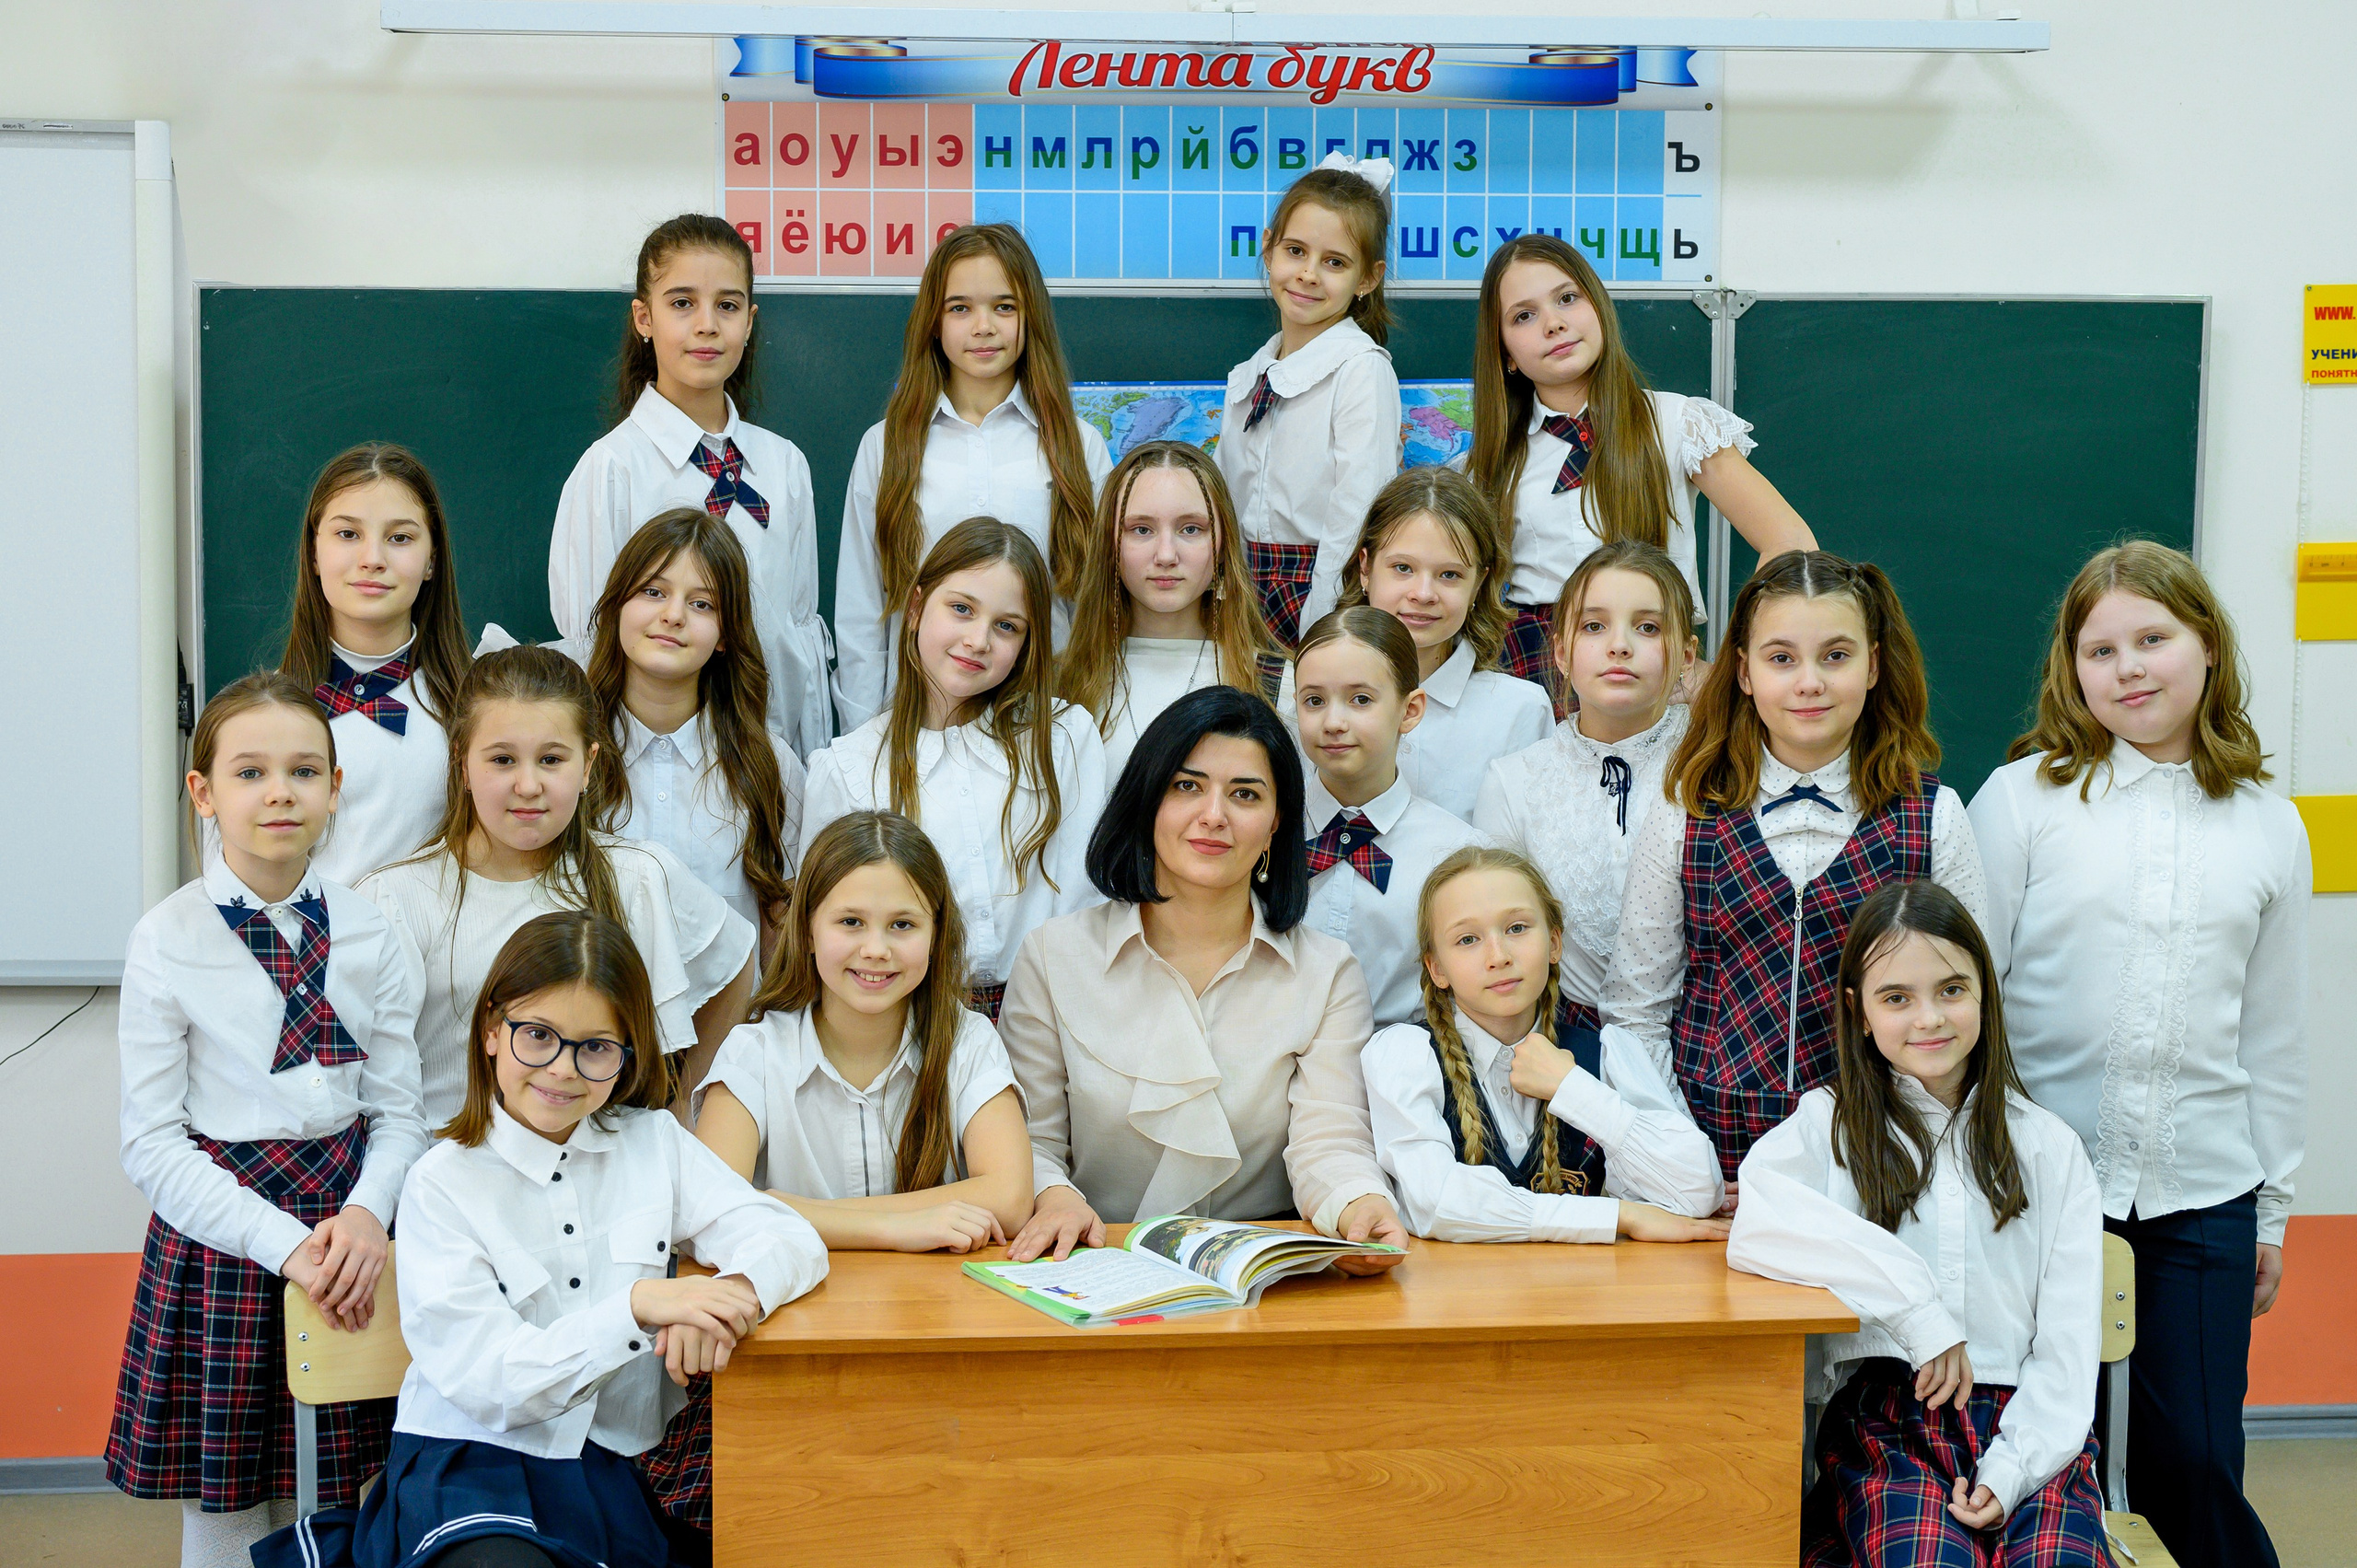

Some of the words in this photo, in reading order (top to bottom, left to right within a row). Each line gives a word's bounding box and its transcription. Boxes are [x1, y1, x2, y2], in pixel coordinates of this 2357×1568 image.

[1008, 40, 1253, 97] Лента
[1267, 45, 1435, 105] букв
[735, 133, 761, 167] а
[779, 133, 810, 167] о
[830, 134, 859, 179] у
[878, 135, 919, 167] ы
[935, 135, 963, 168] э
[984, 135, 1012, 168] н
[1032, 136, 1066, 168] м
[1081, 136, 1112, 169] л
[1132, 135, 1160, 180] р
[1182, 125, 1209, 169] й
[1229, 124, 1260, 169] б
[1278, 137, 1306, 169] в
[1402, 139, 1440, 171] ж
[1453, 138, 1478, 172] з
[782, 209, 809, 254] ё
[825, 222, 866, 255] ю
[886, 223, 913, 255] и
[1231, 226, 1257, 257] п
[1400, 226, 1439, 258] ш
[1453, 226, 1480, 258] с
[1580, 227, 1605, 259] ч
[1620, 228, 1660, 267] щ
